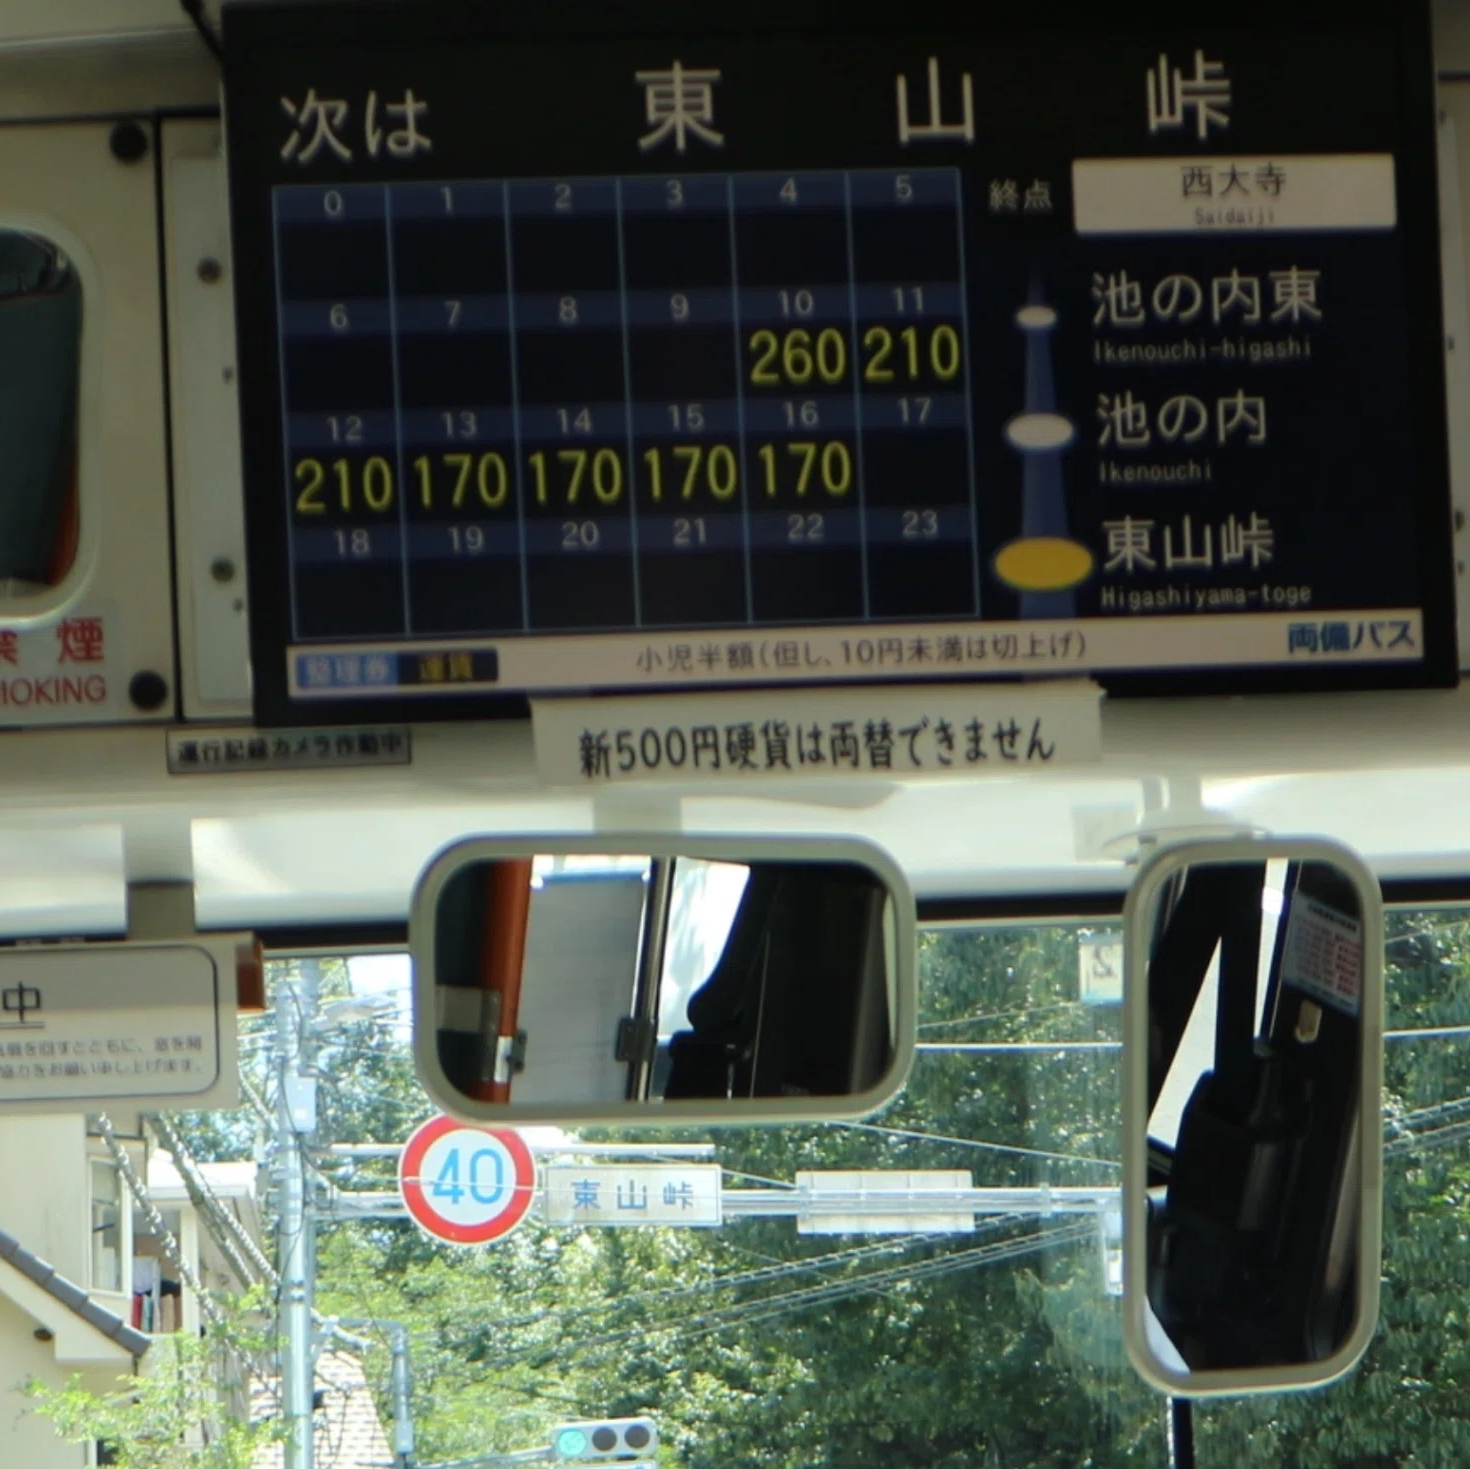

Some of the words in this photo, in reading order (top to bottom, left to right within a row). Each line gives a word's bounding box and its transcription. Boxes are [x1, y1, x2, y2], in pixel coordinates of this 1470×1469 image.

[281, 88, 431, 162] 次は
[666, 180, 684, 207] 3
[778, 177, 799, 204] 4
[894, 174, 913, 200] 5
[1182, 162, 1287, 198] 西大寺
[323, 190, 343, 216] 0
[441, 186, 454, 212] 1
[554, 184, 573, 210] 2
[989, 178, 1054, 212] 終点
[1194, 206, 1276, 228] Saidaiji
[558, 297, 579, 324] 8
[669, 293, 690, 320] 9
[778, 289, 814, 316] 10
[892, 286, 925, 313] 11
[1091, 264, 1324, 330] 池の内東
[329, 303, 349, 329] 6
[444, 300, 461, 327] 7
[748, 327, 847, 384] 260
[863, 325, 960, 381] 210
[1093, 334, 1313, 364] Ikenouchi-higashi
[441, 410, 478, 439] 13
[556, 407, 594, 435] 14
[669, 403, 705, 431] 15
[783, 400, 820, 428] 16
[898, 397, 931, 424] 17
[1097, 388, 1268, 448] 池の内
[327, 414, 365, 443] 12
[413, 452, 508, 509] 170
[529, 448, 624, 504] 170
[643, 444, 737, 500] 170
[758, 441, 853, 497] 170
[1099, 457, 1213, 484] Ikenouchi
[295, 456, 394, 513] 210
[561, 521, 600, 550] 20
[672, 518, 709, 546] 21
[787, 514, 826, 542] 22
[901, 510, 939, 538] 23
[334, 528, 371, 557] 18
[447, 525, 485, 553] 19
[1102, 511, 1276, 573] 東山峠
[1101, 582, 1313, 610] Higashiyama-toge
[1287, 617, 1417, 656] 両備バス
[578, 715, 1056, 779] 新500円硬貨は両替できません
[431, 1147, 506, 1206] 40
[571, 1178, 694, 1211] 東山峠
